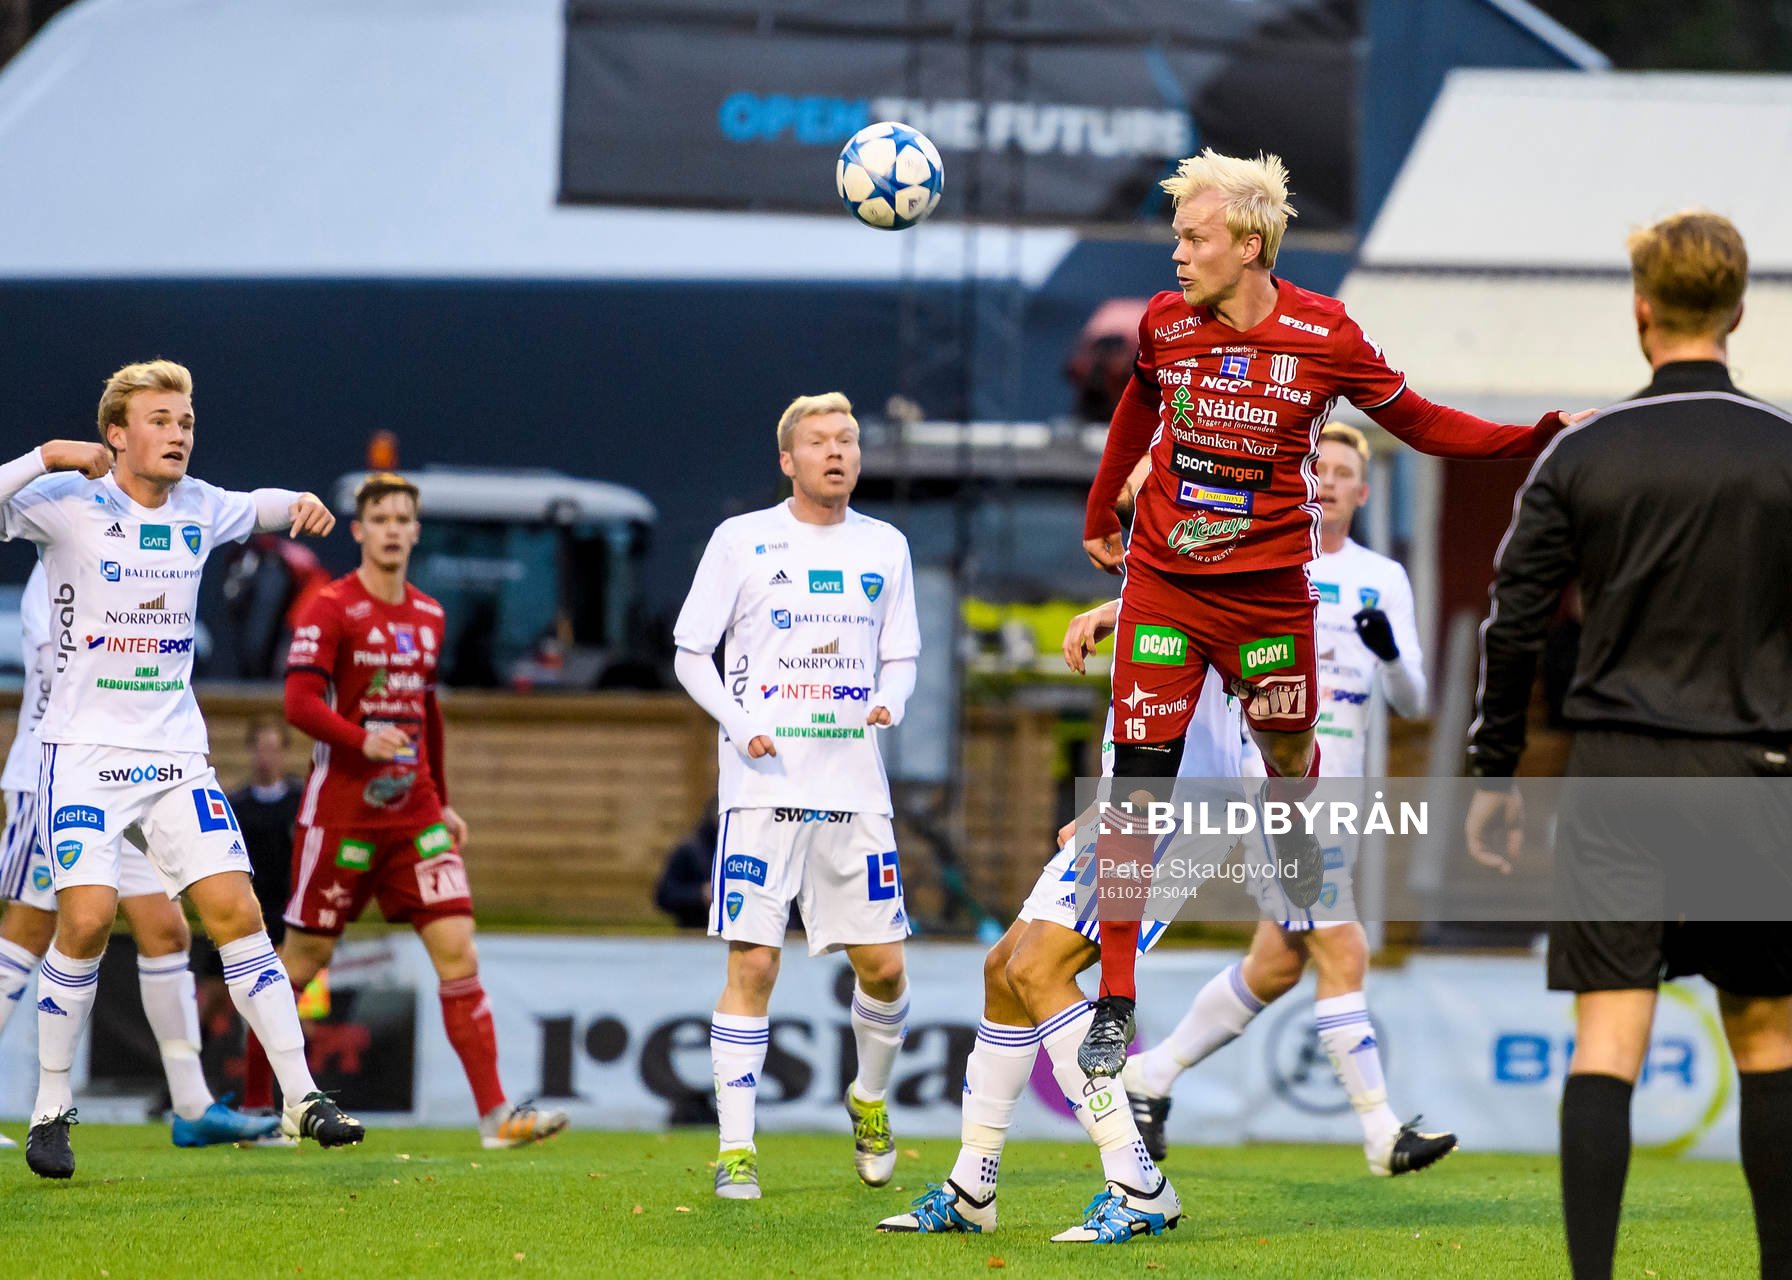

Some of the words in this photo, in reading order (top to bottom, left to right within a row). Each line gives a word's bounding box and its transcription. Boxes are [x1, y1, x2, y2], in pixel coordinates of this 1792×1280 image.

[719, 90, 871, 145] OPEN
[985, 101, 1190, 157] FUTURE
[1154, 316, 1202, 340] ALLSTAR
[1200, 375, 1240, 393] NCC
[1196, 398, 1278, 427] Nåiden
[1241, 438, 1278, 456] Nord
[1176, 453, 1264, 482] sportringen
[142, 537, 168, 548] GATE
[812, 580, 841, 592] GATE
[54, 583, 77, 673] upab
[105, 610, 191, 625] NORRPORTEN
[1139, 634, 1183, 657] OCAY!
[1246, 643, 1288, 668] OCAY!
[1142, 697, 1187, 717] bravida
[1124, 717, 1147, 740] 15
[99, 764, 183, 784] swoosh
[531, 962, 982, 1107] resia
[1495, 1034, 1694, 1088] BR
